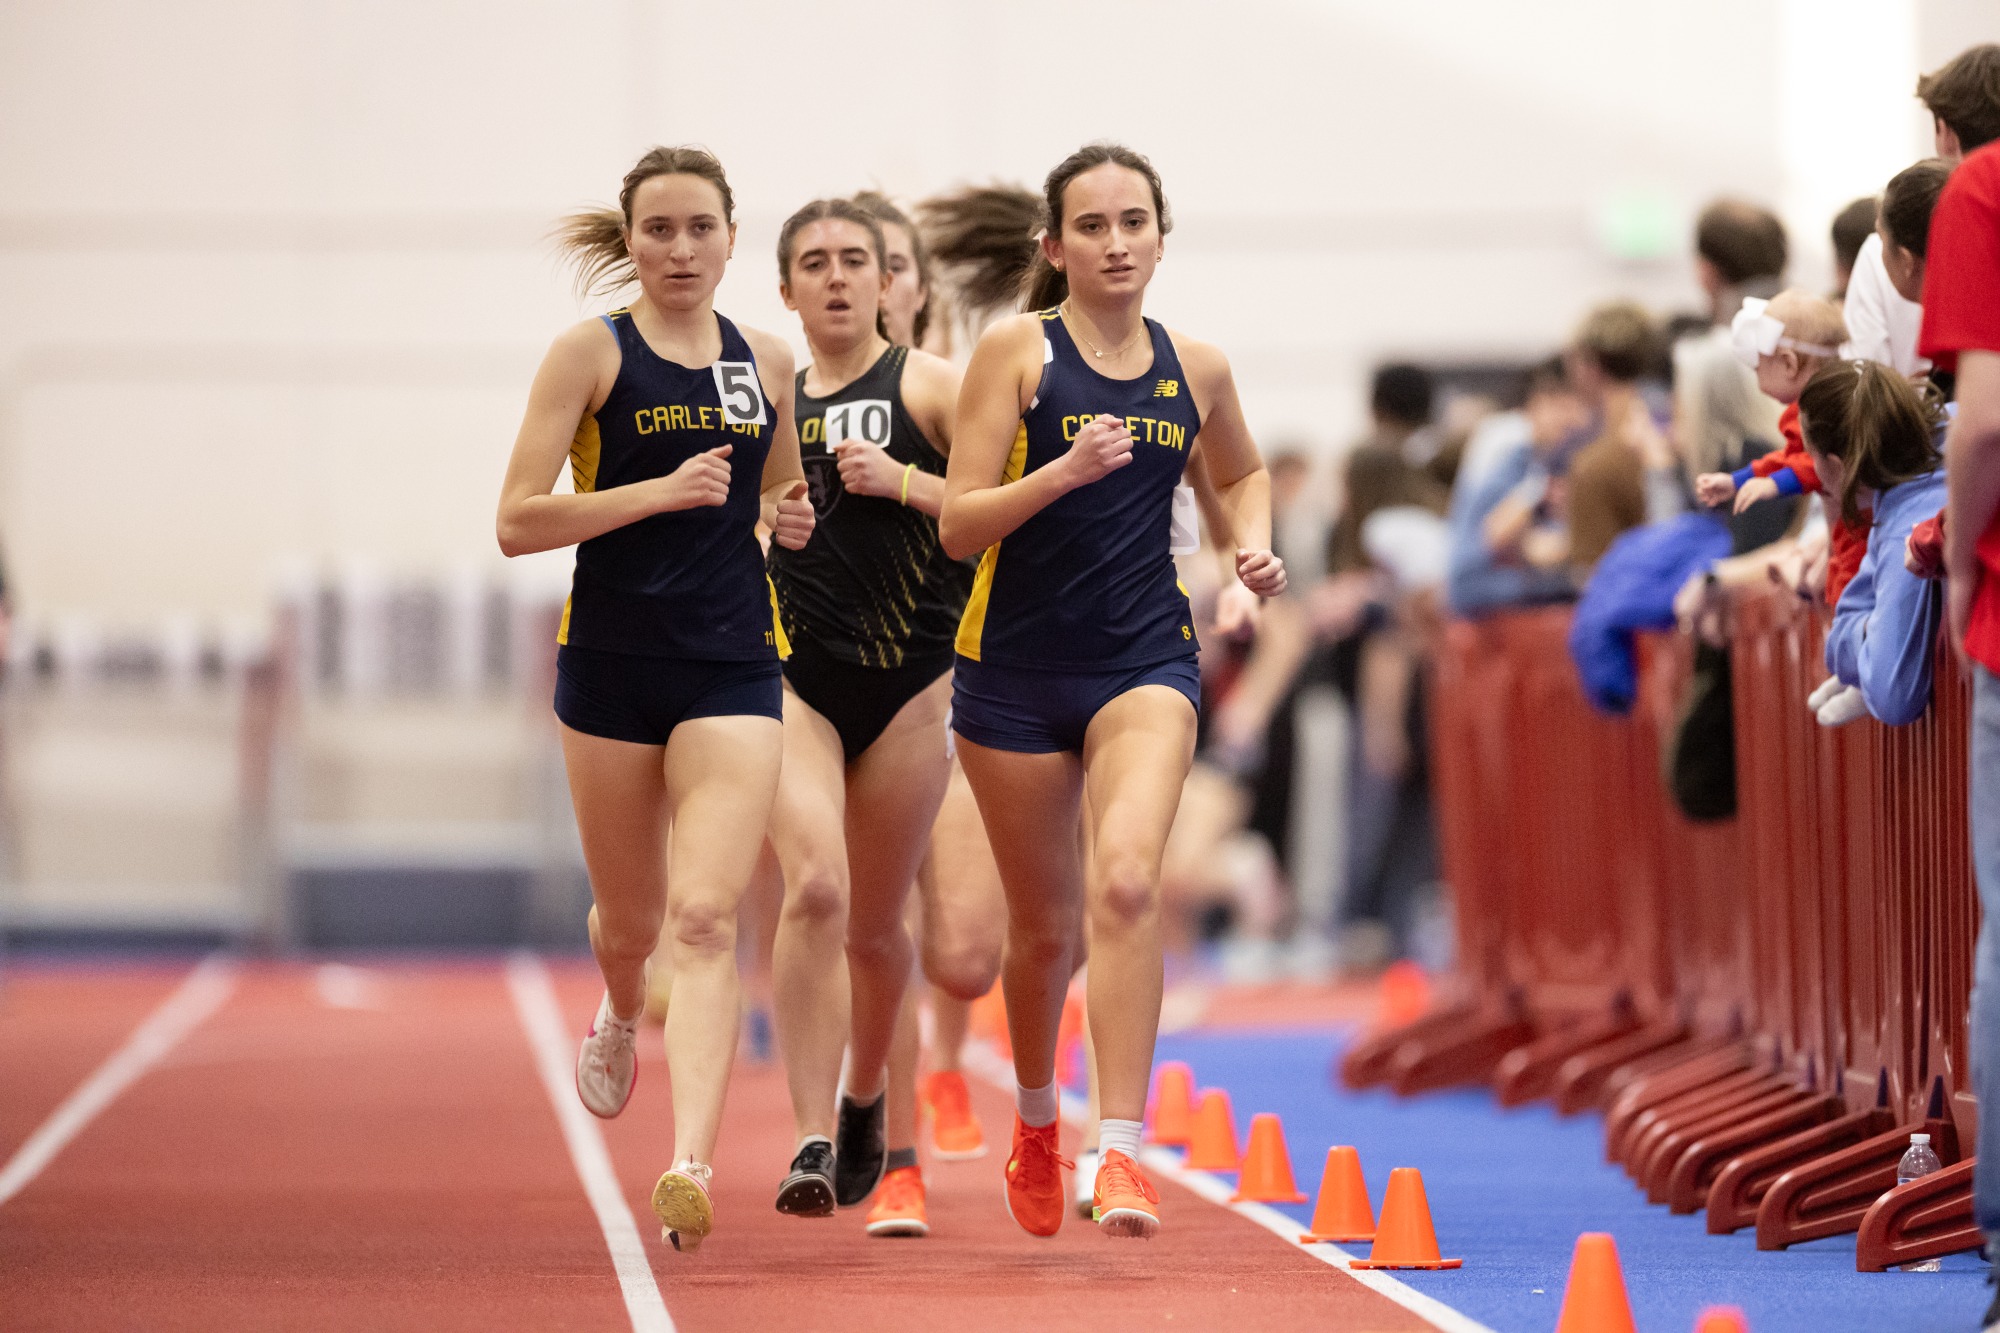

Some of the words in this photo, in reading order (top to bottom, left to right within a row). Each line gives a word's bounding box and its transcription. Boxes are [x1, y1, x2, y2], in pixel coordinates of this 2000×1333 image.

[721, 366, 759, 420] 5
[1153, 379, 1179, 398] NB
[831, 405, 889, 445] 10
[1062, 414, 1185, 450] CETON
[764, 631, 773, 645] 11
[1181, 626, 1191, 640] 8
